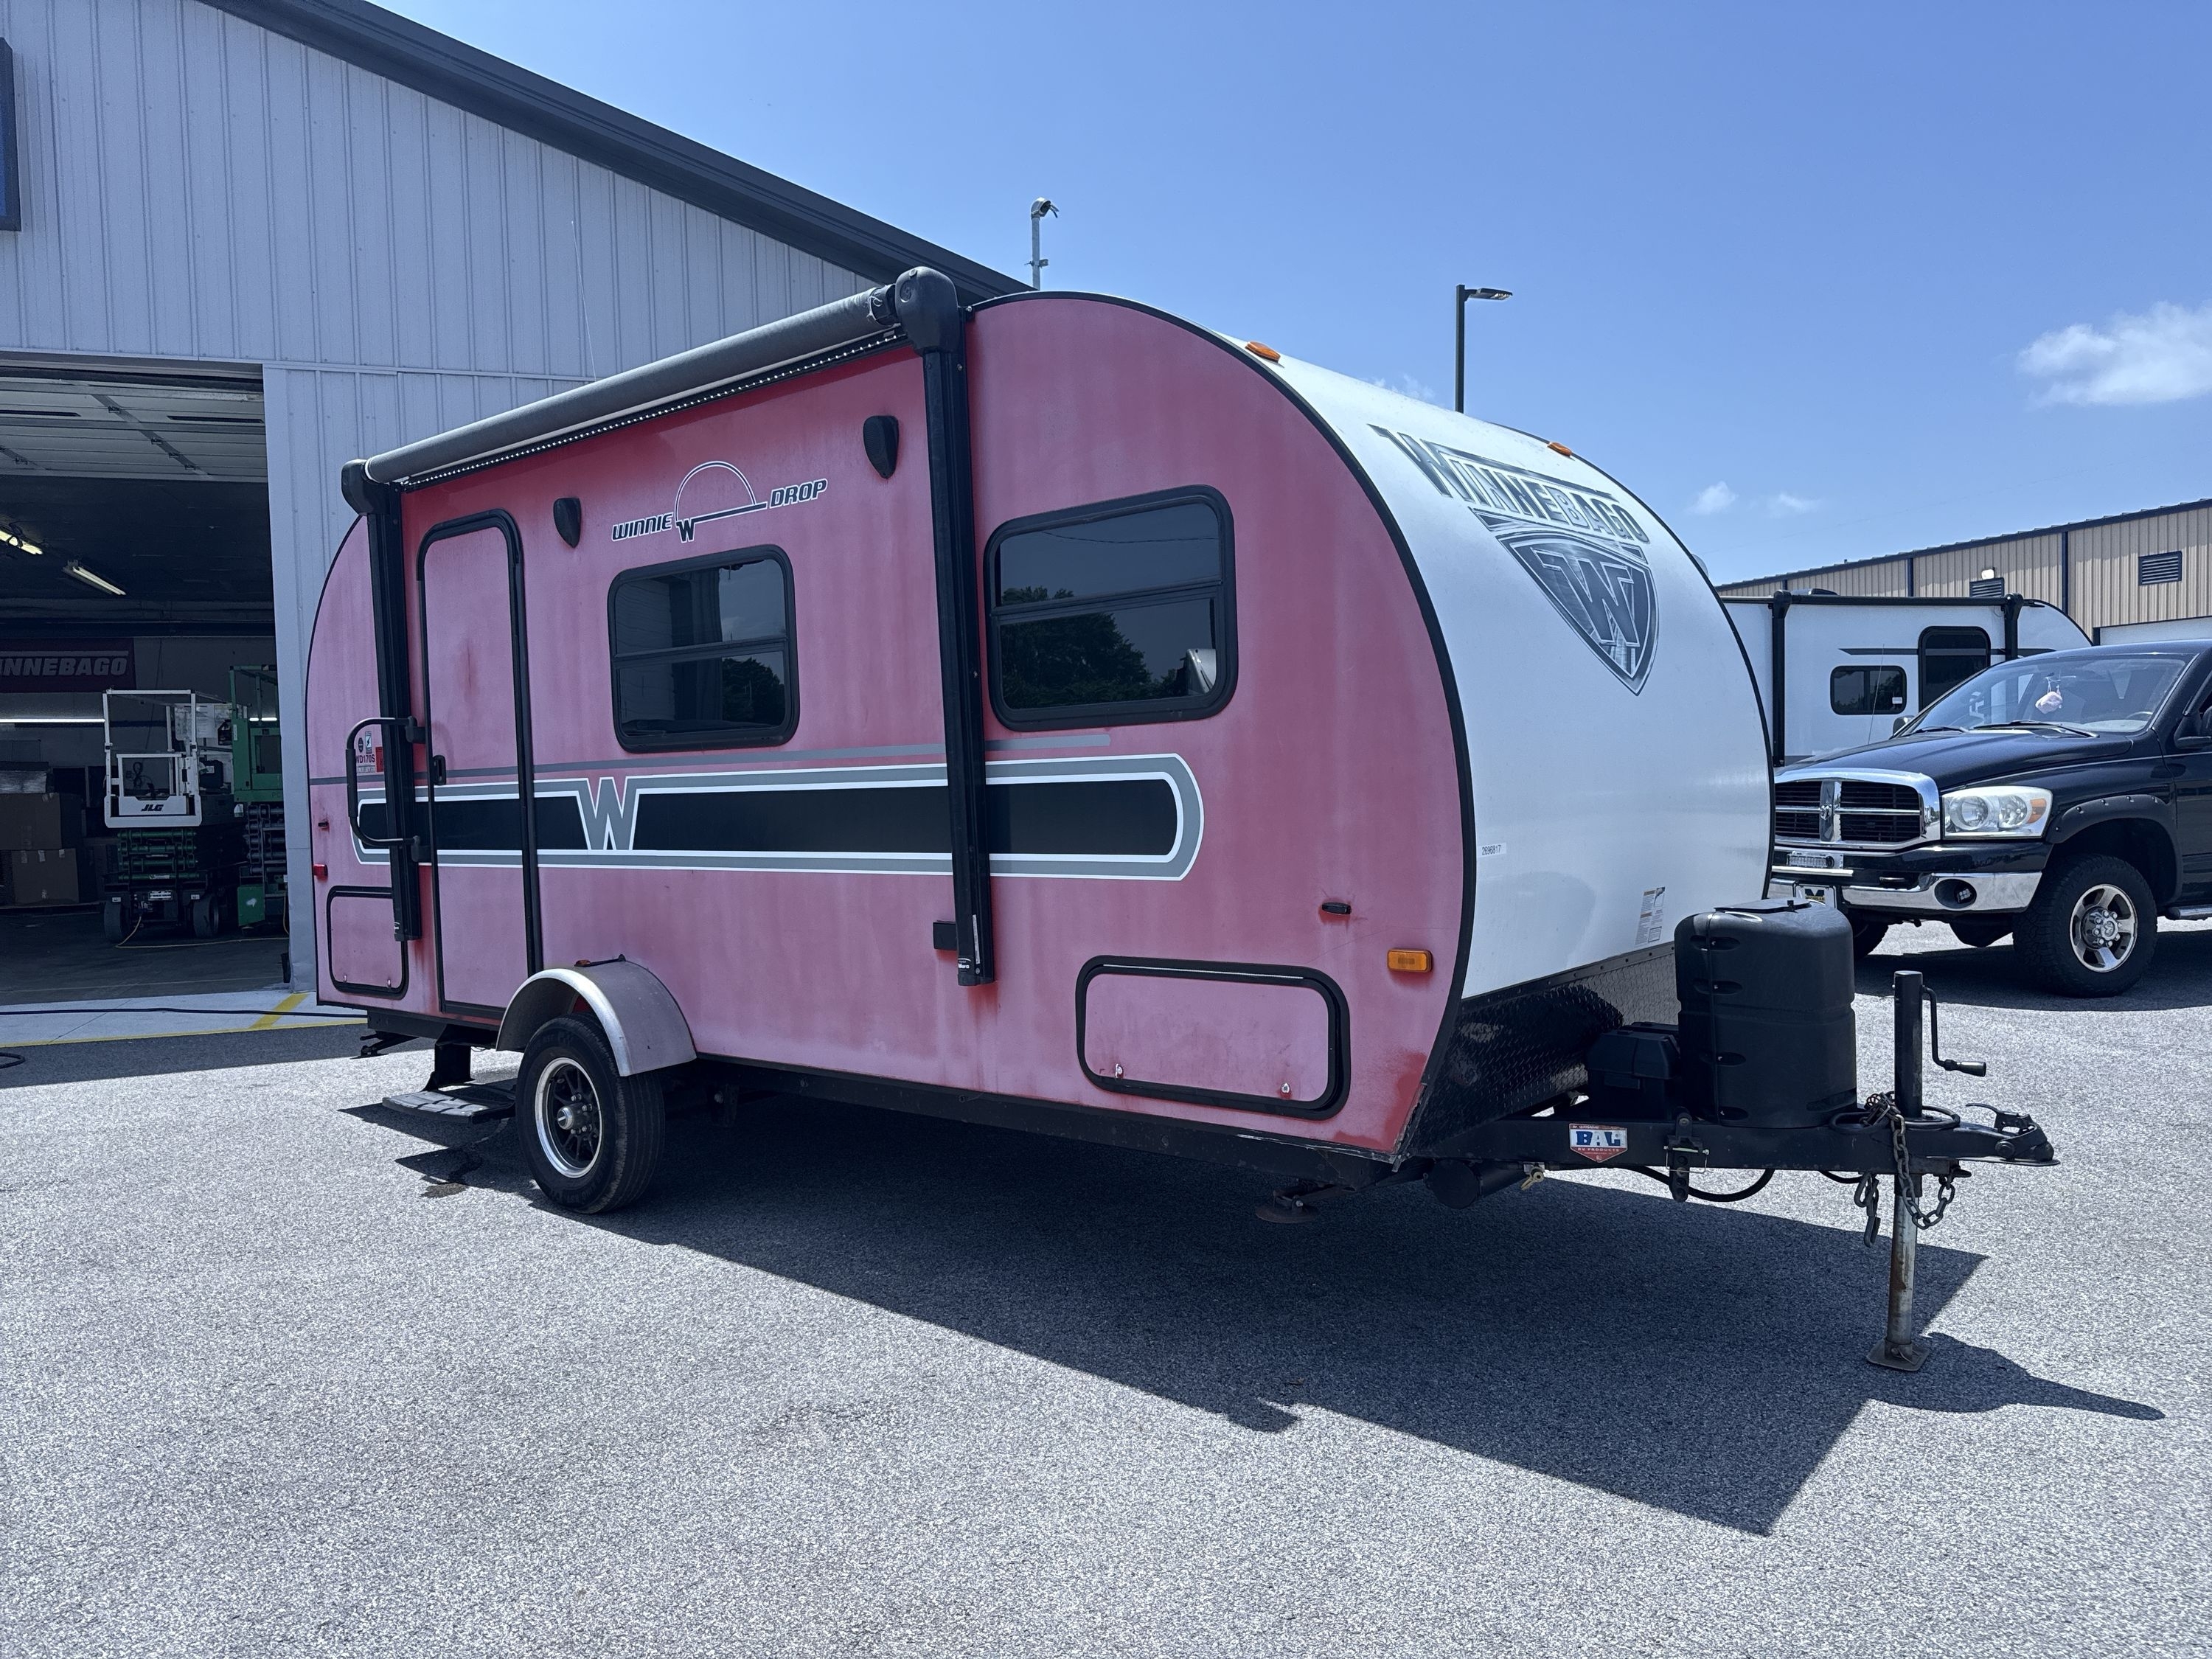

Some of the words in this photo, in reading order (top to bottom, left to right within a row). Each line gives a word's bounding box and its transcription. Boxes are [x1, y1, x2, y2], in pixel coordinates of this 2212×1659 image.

[1366, 423, 1651, 544] WINNEBAGO
[611, 512, 673, 541] WINNIE
[769, 478, 828, 509] DROP
[0, 658, 128, 676] NNEBAGO
[141, 804, 164, 812] JLG
[1576, 1130, 1621, 1147] BAL
